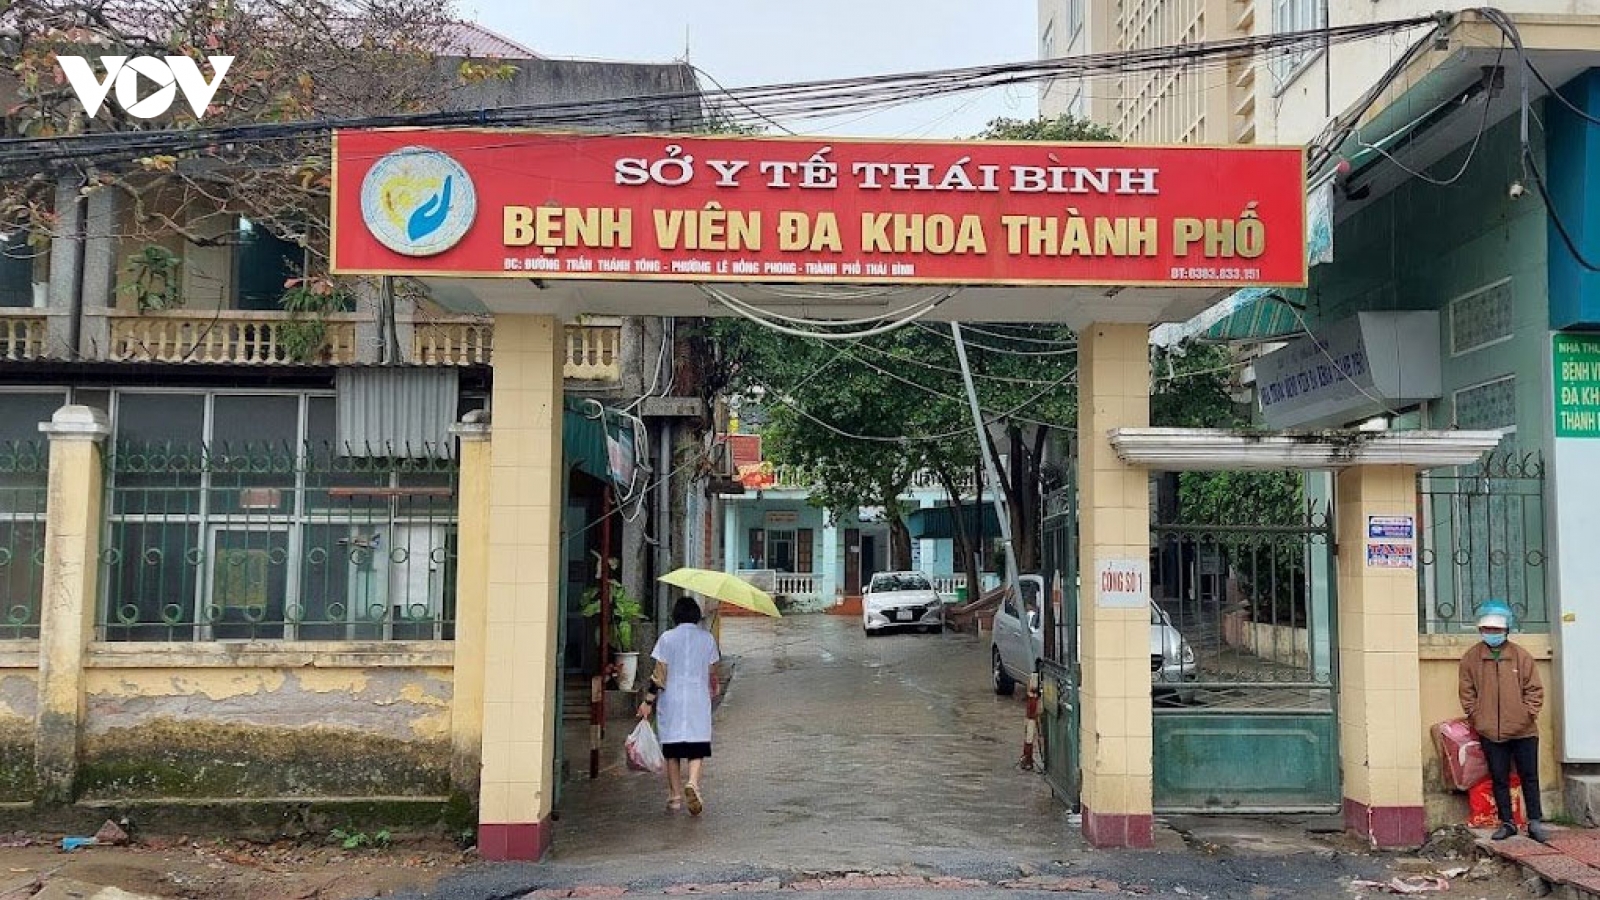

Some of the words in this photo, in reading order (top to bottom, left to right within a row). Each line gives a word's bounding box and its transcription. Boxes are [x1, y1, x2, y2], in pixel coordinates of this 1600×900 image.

[615, 145, 694, 186] SỞ
[706, 160, 749, 187] Y
[760, 146, 837, 190] TẾ
[852, 156, 1000, 192] THÁI
[1009, 153, 1160, 195] BÌNH
[777, 210, 842, 252] ĐA
[861, 212, 987, 254] KHOA
[1001, 207, 1158, 256] THÀNH
[1172, 201, 1265, 258] PHỐ
[598, 257, 630, 271] THÁNH
[764, 262, 796, 274] PHONG
[1561, 386, 1579, 405] ĐA
[1581, 386, 1600, 406] KH
[1138, 571, 1142, 593] 1
